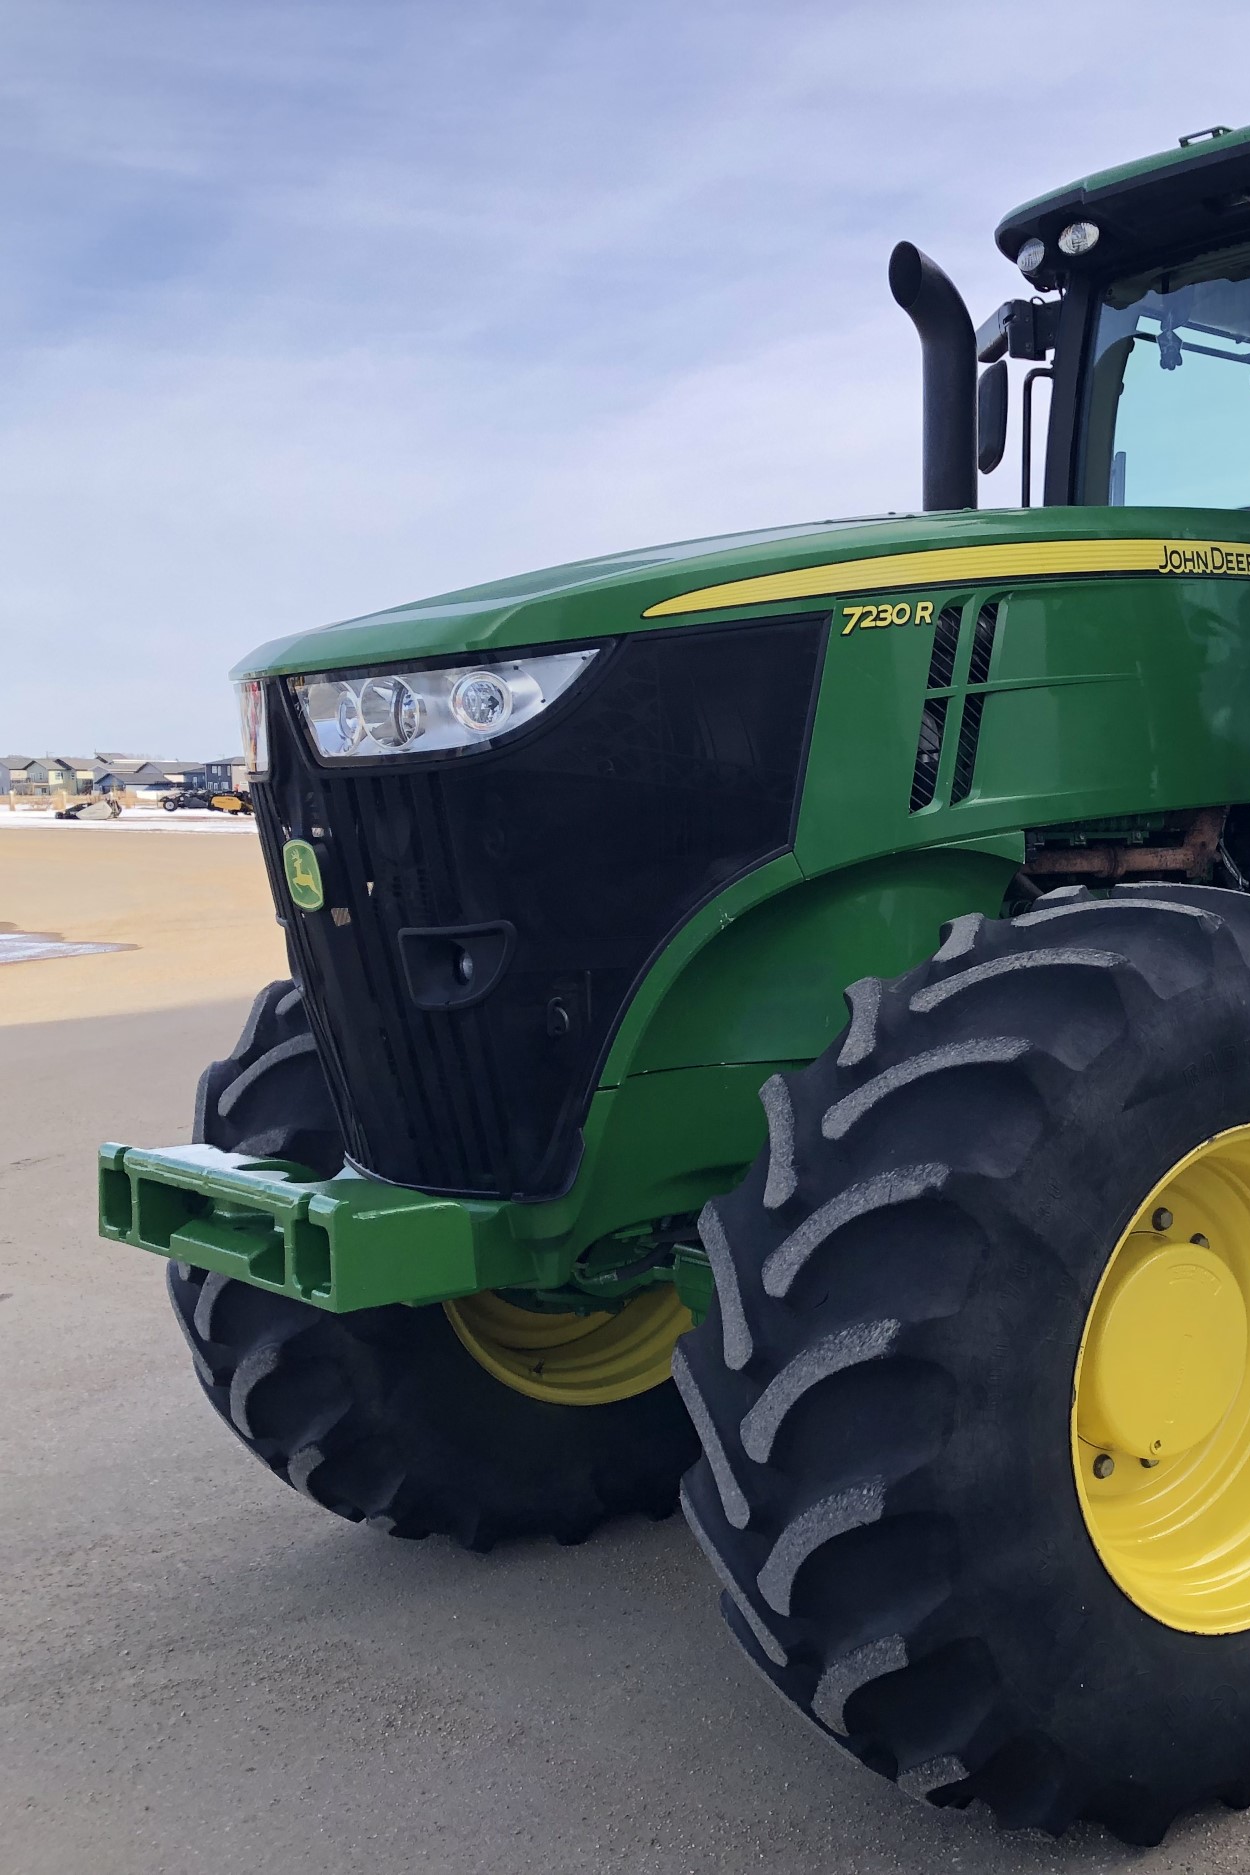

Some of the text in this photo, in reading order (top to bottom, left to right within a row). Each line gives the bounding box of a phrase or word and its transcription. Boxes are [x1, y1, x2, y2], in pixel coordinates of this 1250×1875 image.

[1159, 545, 1209, 570] JOHN
[841, 601, 934, 636] 7230 R
